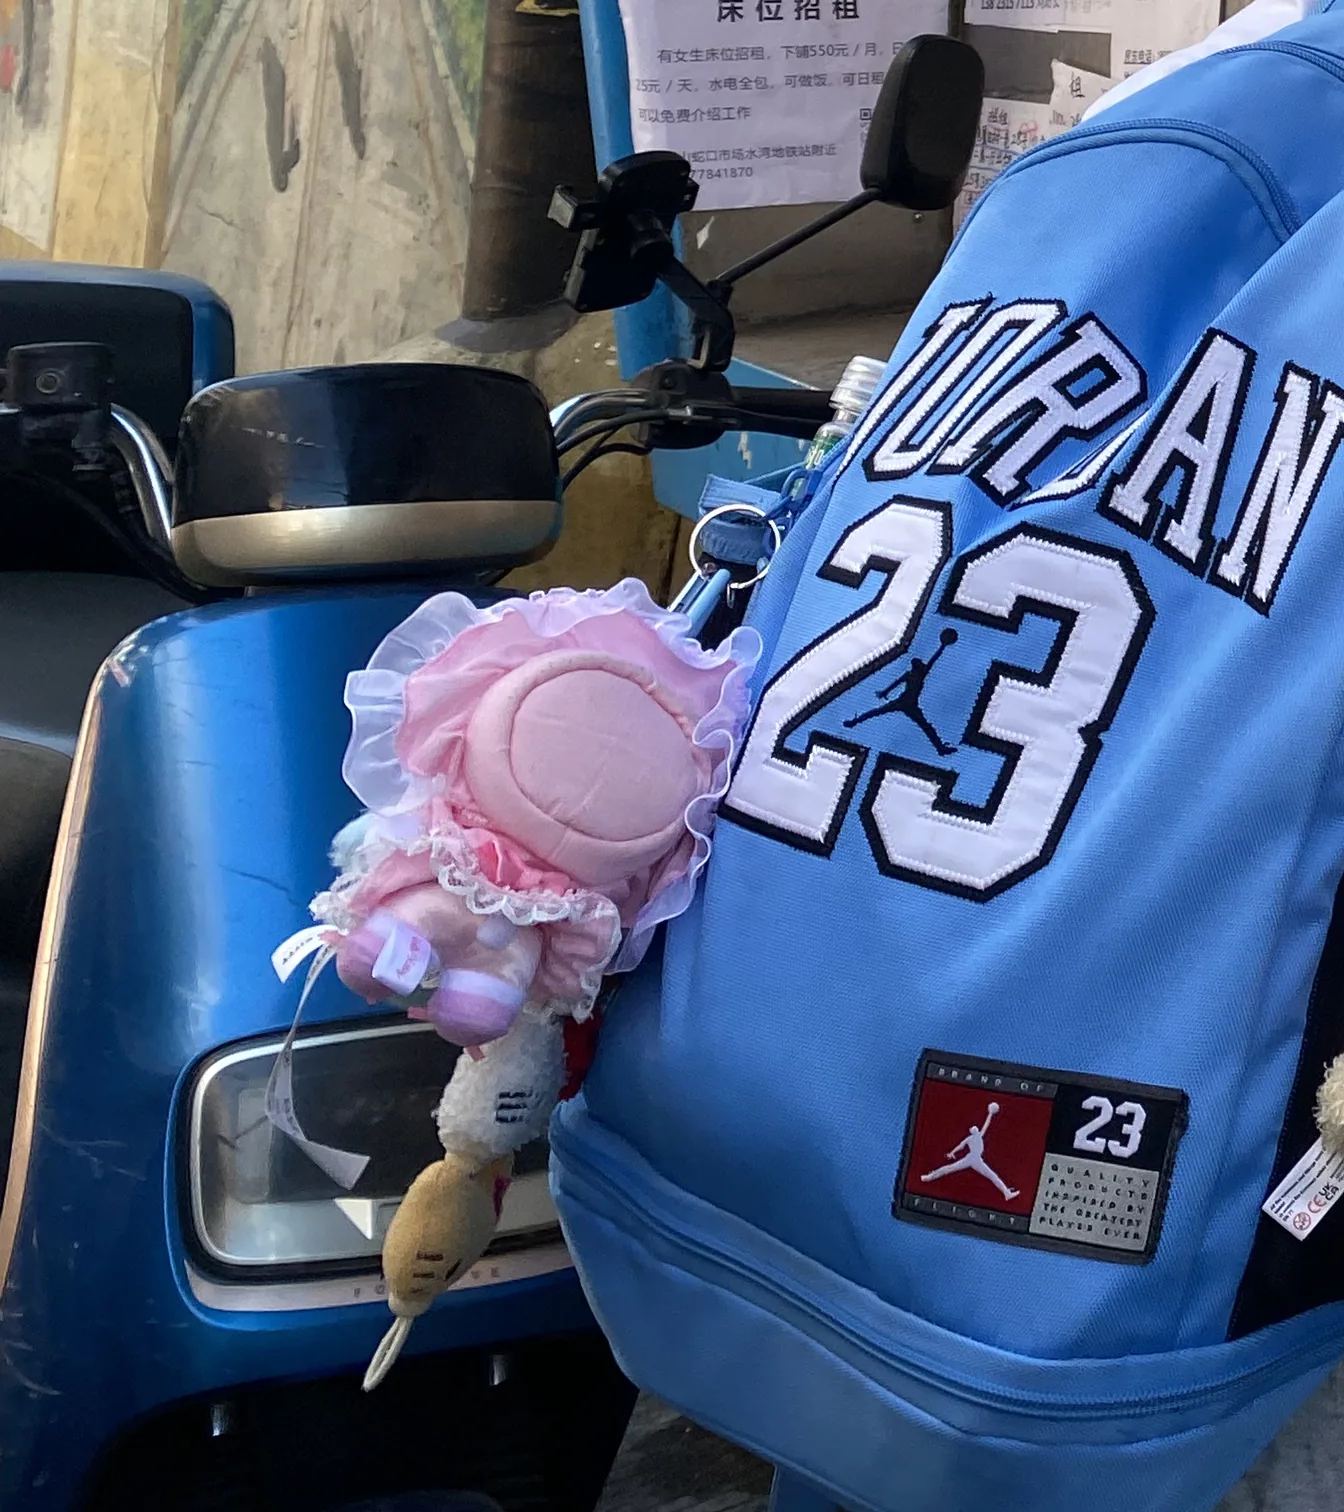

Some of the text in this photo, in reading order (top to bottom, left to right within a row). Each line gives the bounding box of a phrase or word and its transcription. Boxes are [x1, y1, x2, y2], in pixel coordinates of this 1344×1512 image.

[717, 494, 1157, 904] 23
[938, 1068, 1044, 1092] BRAND OF
[1073, 1095, 1147, 1159] 23
[914, 1198, 1015, 1225] FLIGHT
